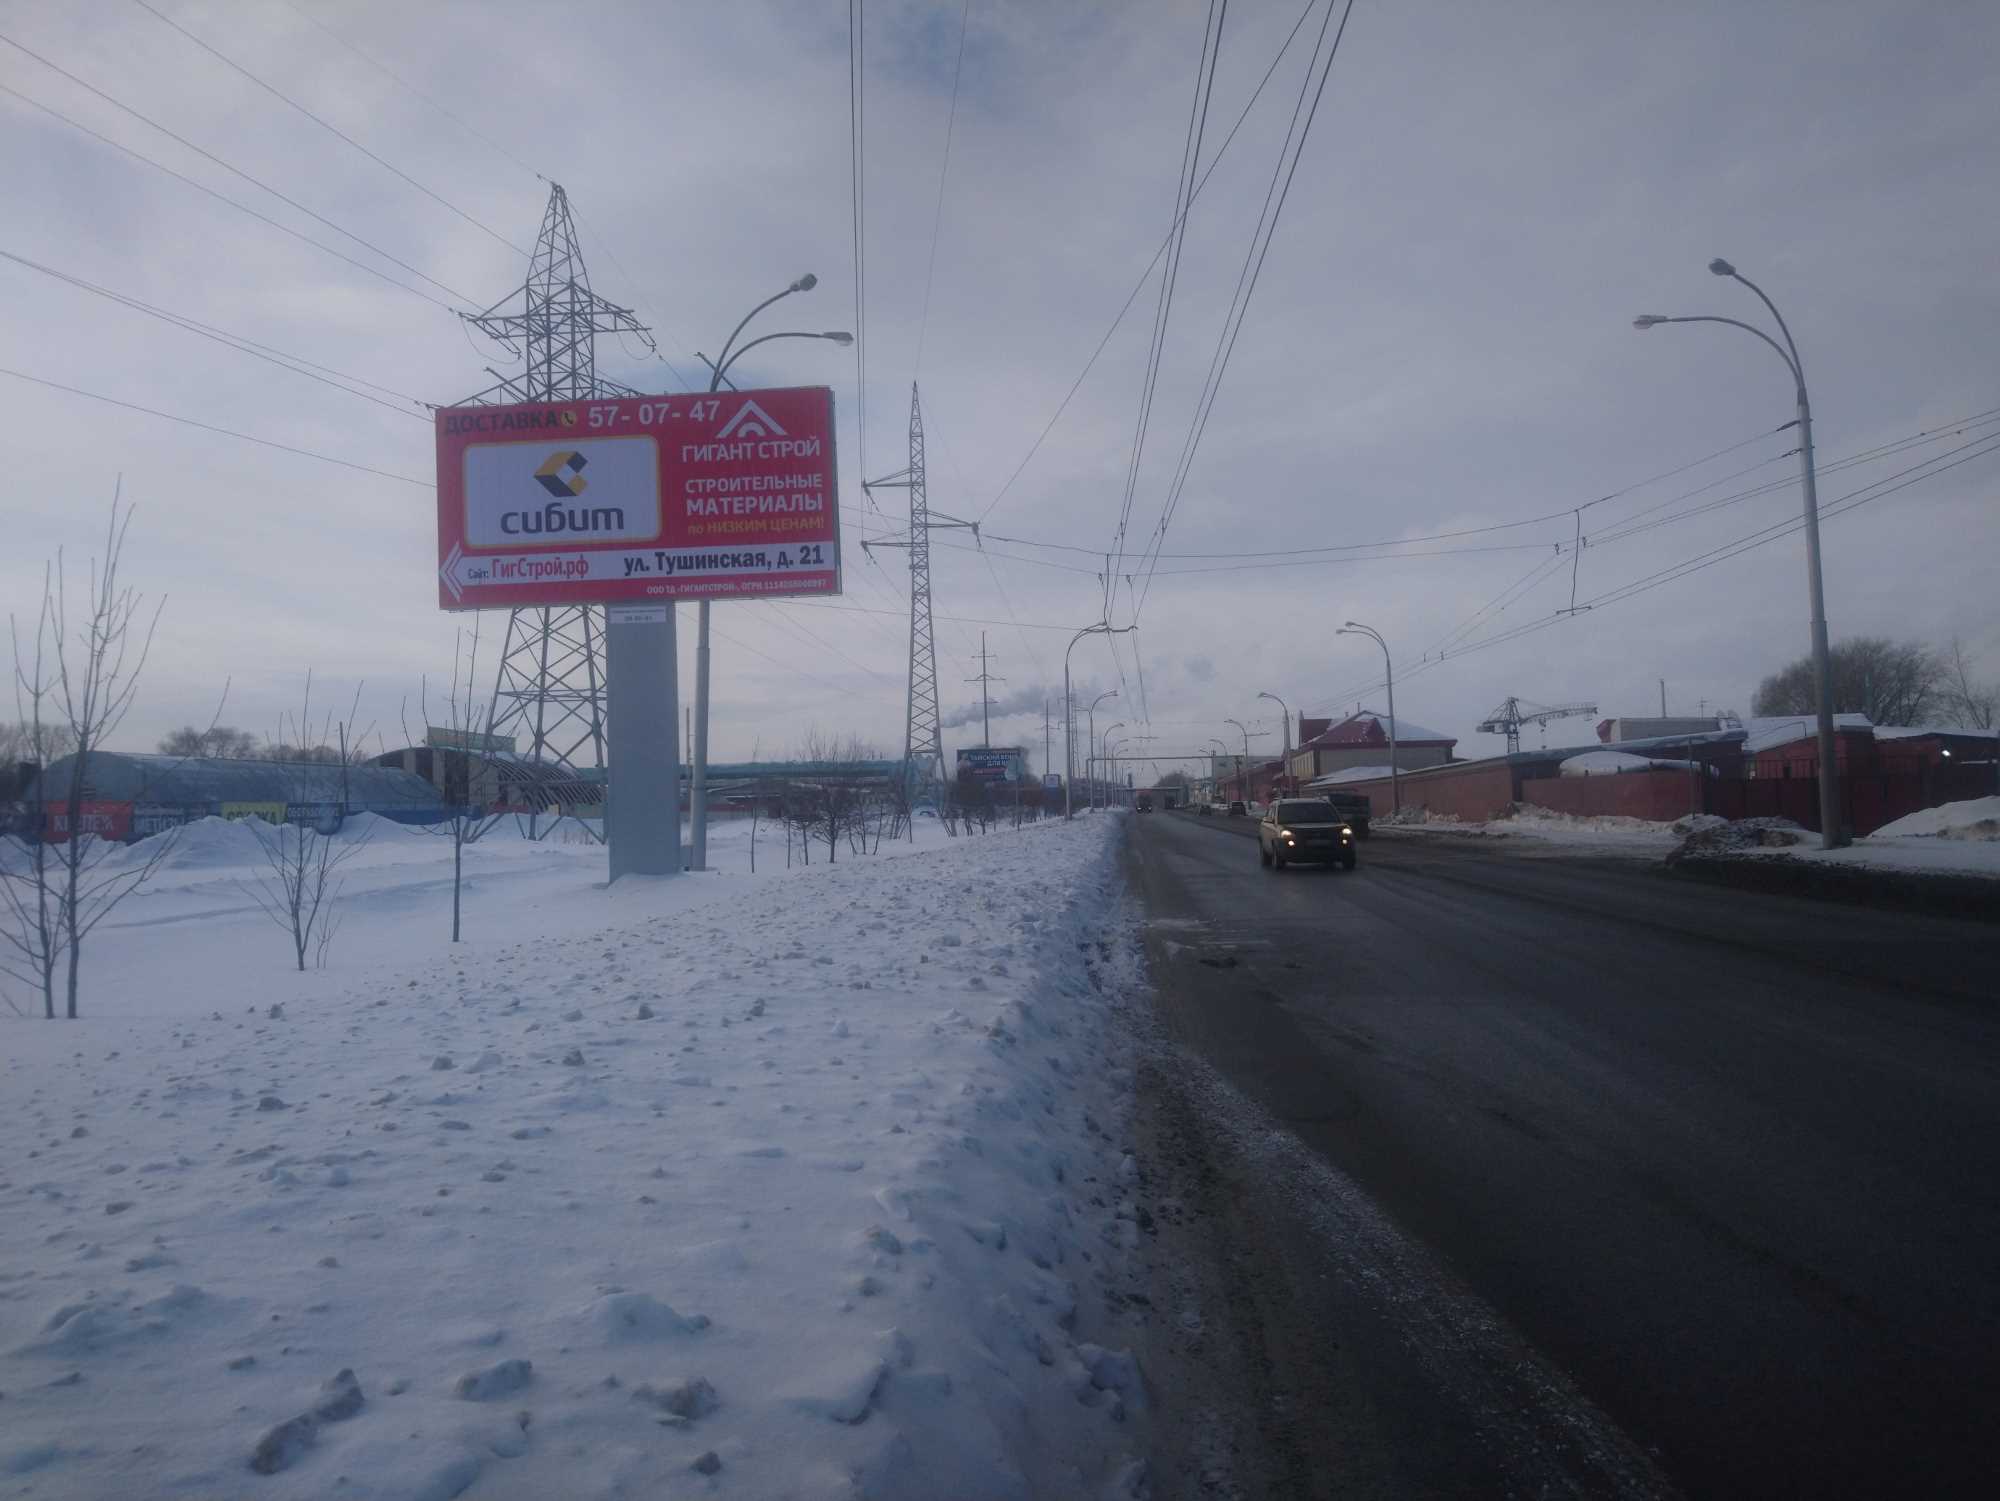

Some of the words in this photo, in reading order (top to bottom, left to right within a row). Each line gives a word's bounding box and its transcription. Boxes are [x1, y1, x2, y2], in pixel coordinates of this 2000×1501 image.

[445, 410, 558, 436] ДОСТАВКА
[682, 442, 754, 463] ГИГАНТ
[758, 435, 820, 459] СТРОЙ
[685, 473, 823, 493] СТРОИТЕЛЬНЫЕ
[686, 493, 823, 516] МАТЕРИАЛЫ
[500, 502, 625, 534] сибит
[707, 518, 767, 534] НИЗКИМ
[491, 555, 589, 580] ГигСтрой.рф
[624, 557, 650, 577] ул.
[655, 551, 772, 576] Тушинская,
[776, 551, 794, 569] д.
[799, 545, 825, 565] 21
